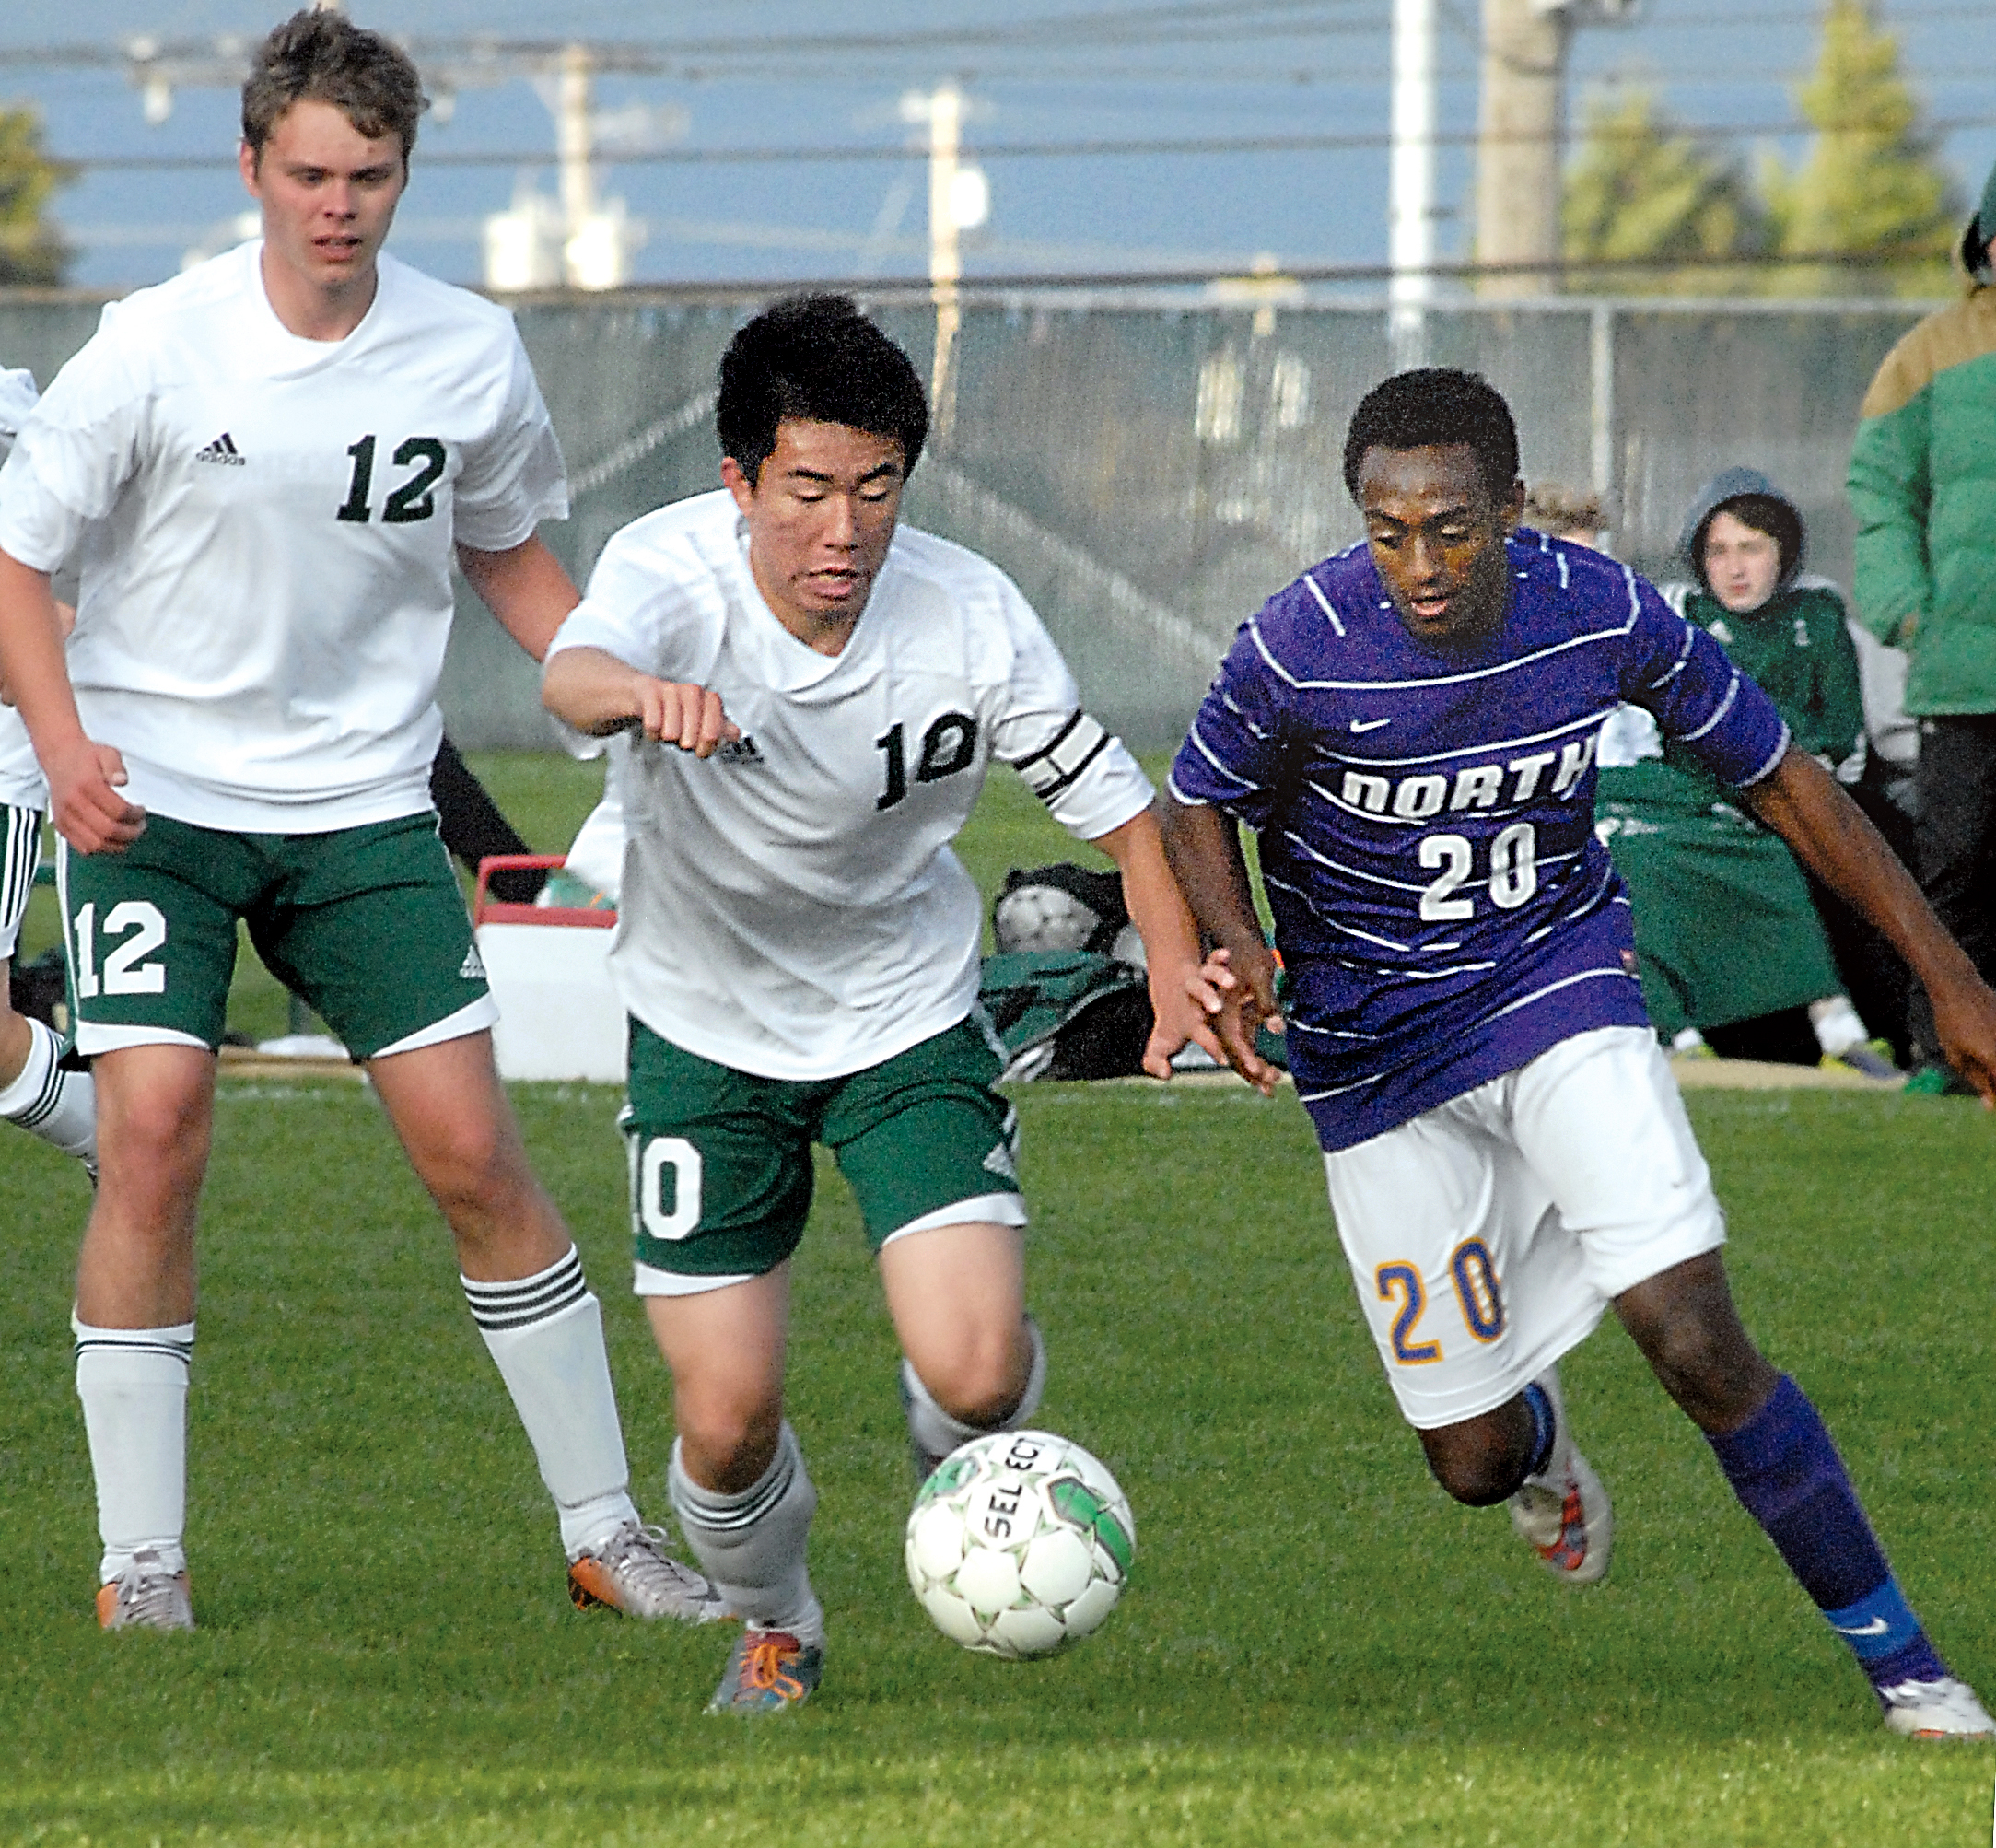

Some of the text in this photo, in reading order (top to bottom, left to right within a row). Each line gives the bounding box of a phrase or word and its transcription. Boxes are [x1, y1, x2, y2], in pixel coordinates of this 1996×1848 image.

[336, 434, 447, 523] 12
[1341, 734, 1597, 819] NORTH
[1418, 823, 1537, 921] 20
[74, 901, 167, 999] 12
[1375, 1235, 1506, 1365] 20
[984, 1437, 1045, 1538] SELECT
